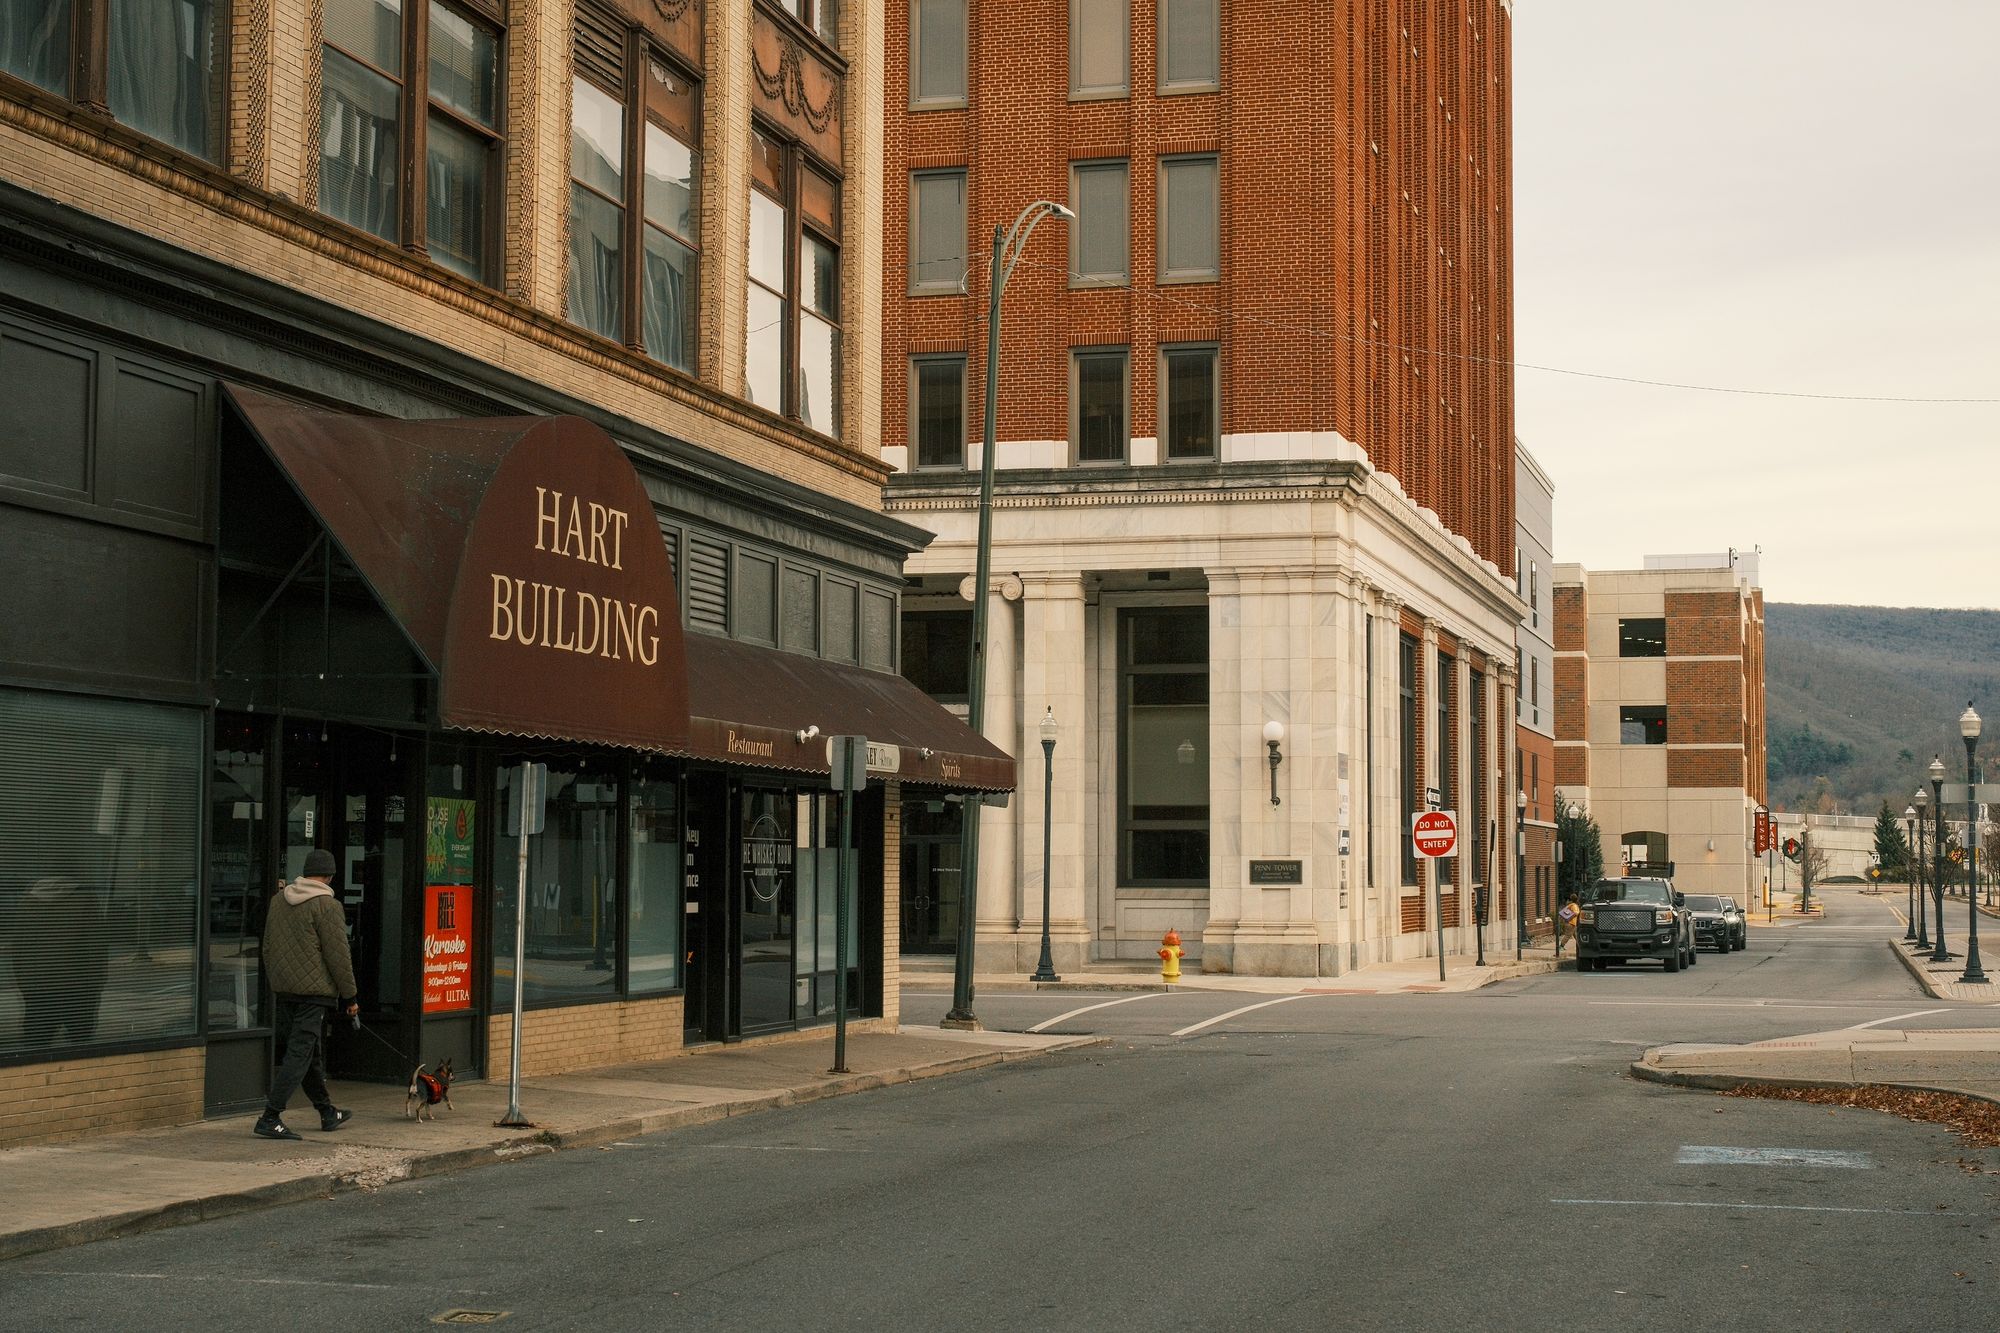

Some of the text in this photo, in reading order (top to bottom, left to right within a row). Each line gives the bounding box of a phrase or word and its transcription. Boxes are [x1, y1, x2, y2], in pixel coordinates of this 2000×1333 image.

[535, 486, 628, 570] HART
[490, 573, 659, 666] BUILDING
[728, 729, 773, 757] Restaurant
[941, 758, 961, 780] Spirits
[1419, 820, 1450, 829] DO NOT
[686, 825, 699, 848] key
[1423, 840, 1448, 849] ENTER
[743, 843, 791, 865] HE WHISKEY ROOM
[686, 874, 699, 888] nce
[437, 910, 456, 929] BILL
[424, 934, 467, 959] Karaoke
[446, 990, 470, 1002] ULTRA
